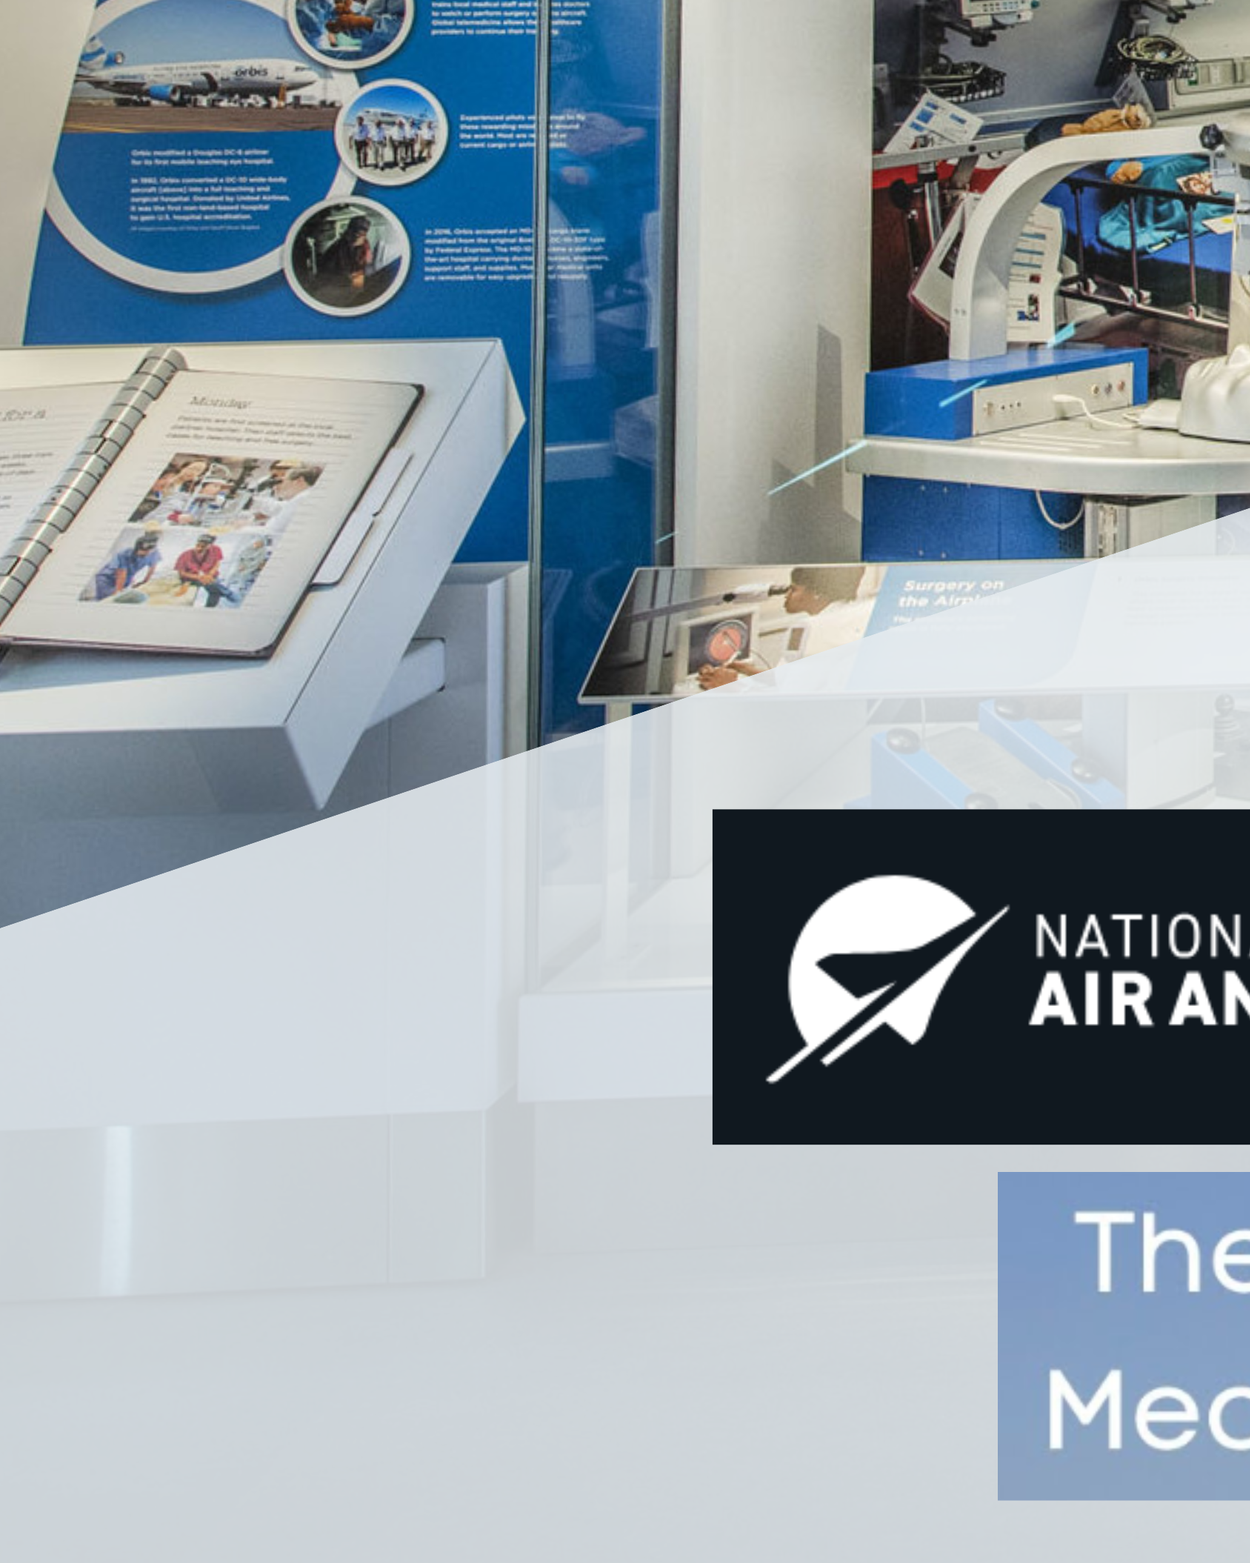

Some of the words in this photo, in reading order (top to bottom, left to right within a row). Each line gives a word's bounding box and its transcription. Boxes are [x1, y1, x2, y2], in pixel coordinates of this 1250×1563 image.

[235, 65, 268, 77] orbis
[190, 396, 252, 409] Monday
[904, 580, 976, 592] Surgery
[981, 580, 1004, 590] on
[898, 595, 929, 607] the
